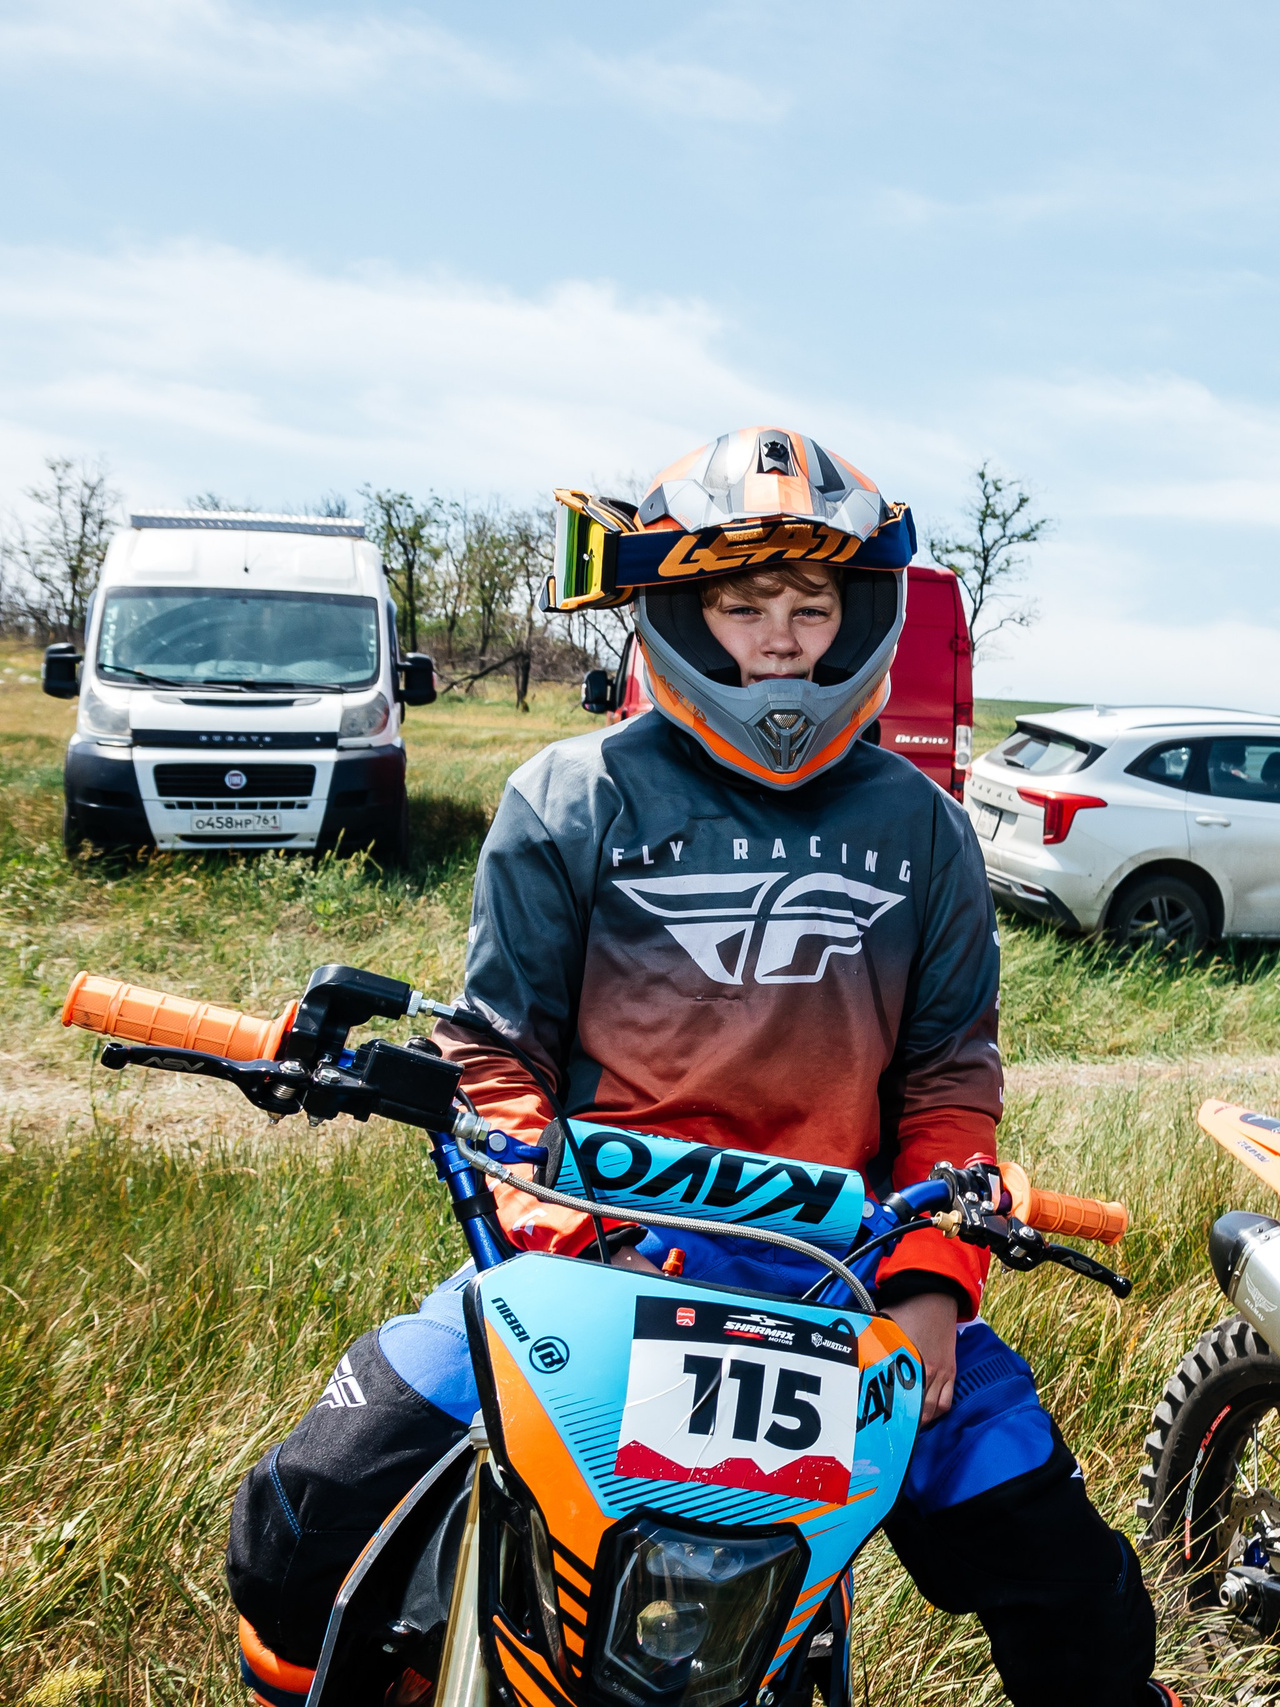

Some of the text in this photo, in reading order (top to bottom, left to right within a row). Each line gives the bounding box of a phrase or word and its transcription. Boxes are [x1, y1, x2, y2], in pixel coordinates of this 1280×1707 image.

[255, 814, 278, 826] 761
[612, 835, 912, 883] FLY RACING
[491, 1297, 531, 1343] NIBBI
[722, 1320, 796, 1341] SHARMAX
[768, 1336, 793, 1346] MOTORS
[683, 1353, 823, 1451] 115
